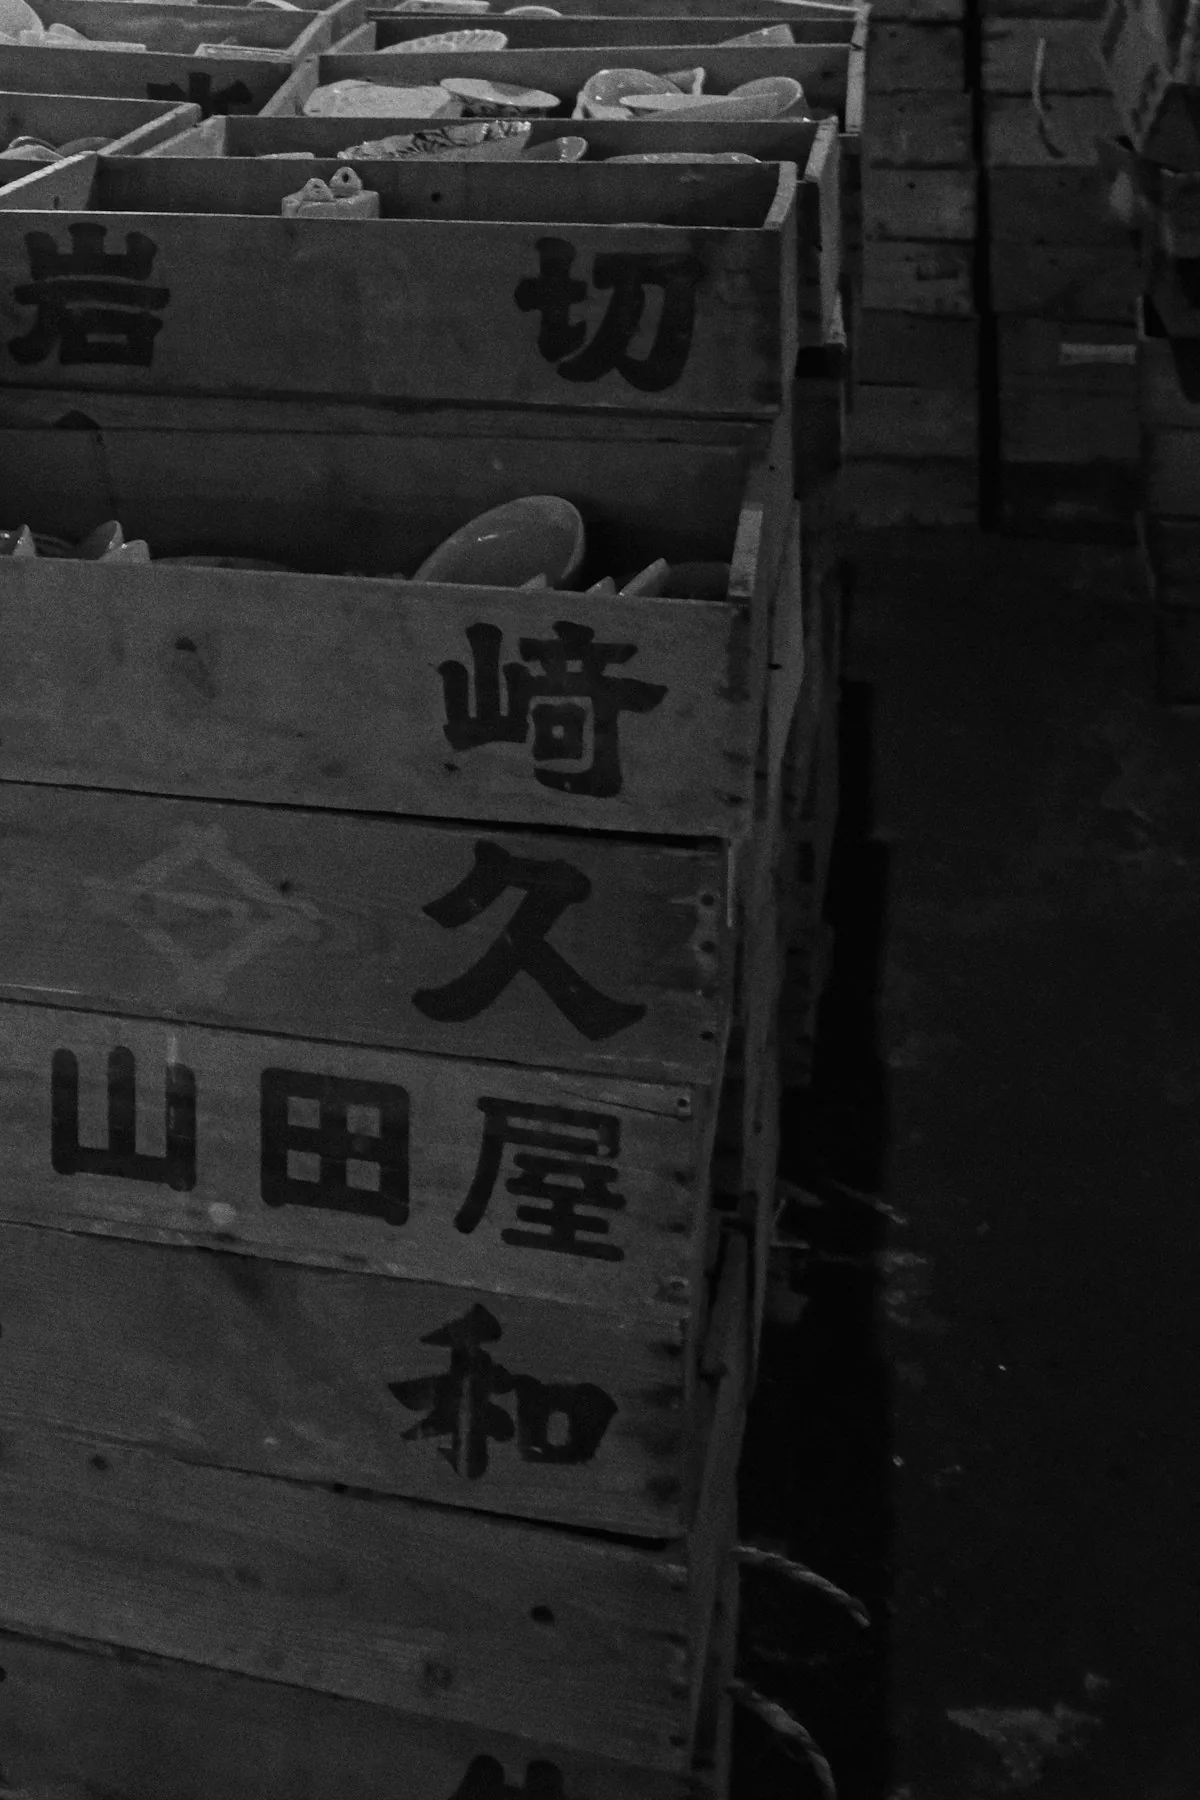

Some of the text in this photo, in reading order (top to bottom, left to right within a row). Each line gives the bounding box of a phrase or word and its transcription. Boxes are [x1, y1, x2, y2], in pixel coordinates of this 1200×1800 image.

[6, 222, 703, 391] 岩 切
[411, 839, 647, 1042] 久
[50, 1045, 627, 1264] 山田屋
[388, 1303, 619, 1480] 和
